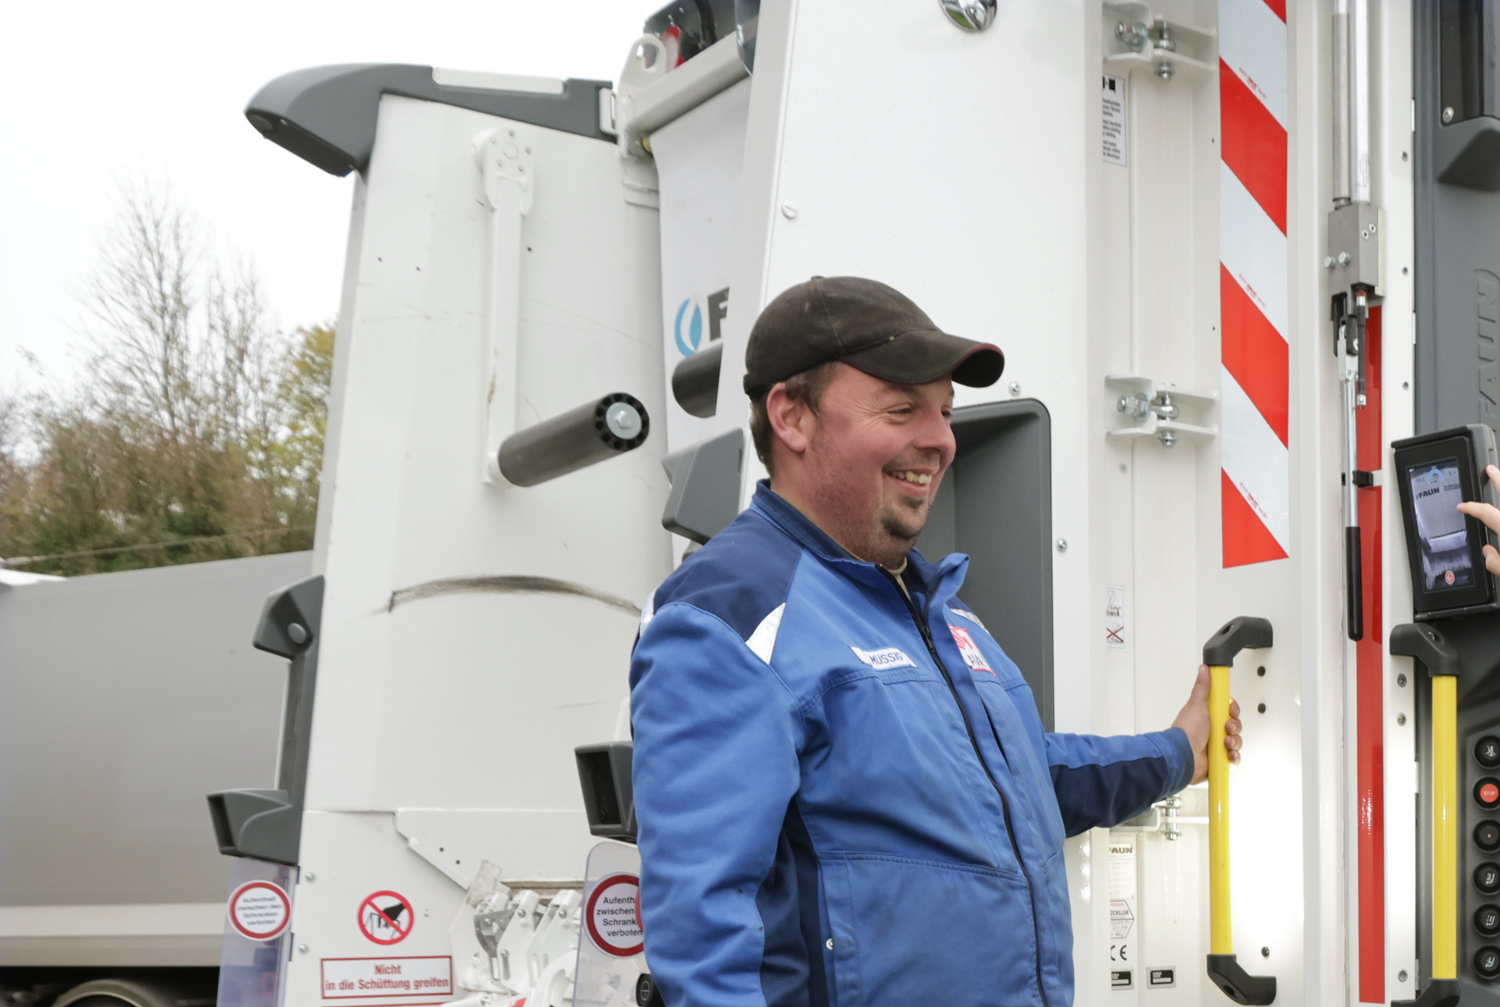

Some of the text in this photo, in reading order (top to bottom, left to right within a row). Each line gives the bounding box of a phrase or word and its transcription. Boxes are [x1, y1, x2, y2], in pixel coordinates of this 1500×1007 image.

[603, 896, 636, 904] Aufenth
[596, 907, 635, 915] zwischen
[603, 918, 637, 926] Schrank
[607, 929, 644, 937] verboten
[374, 964, 402, 975] Nicht
[325, 977, 449, 991] in die Schüttung greifen
